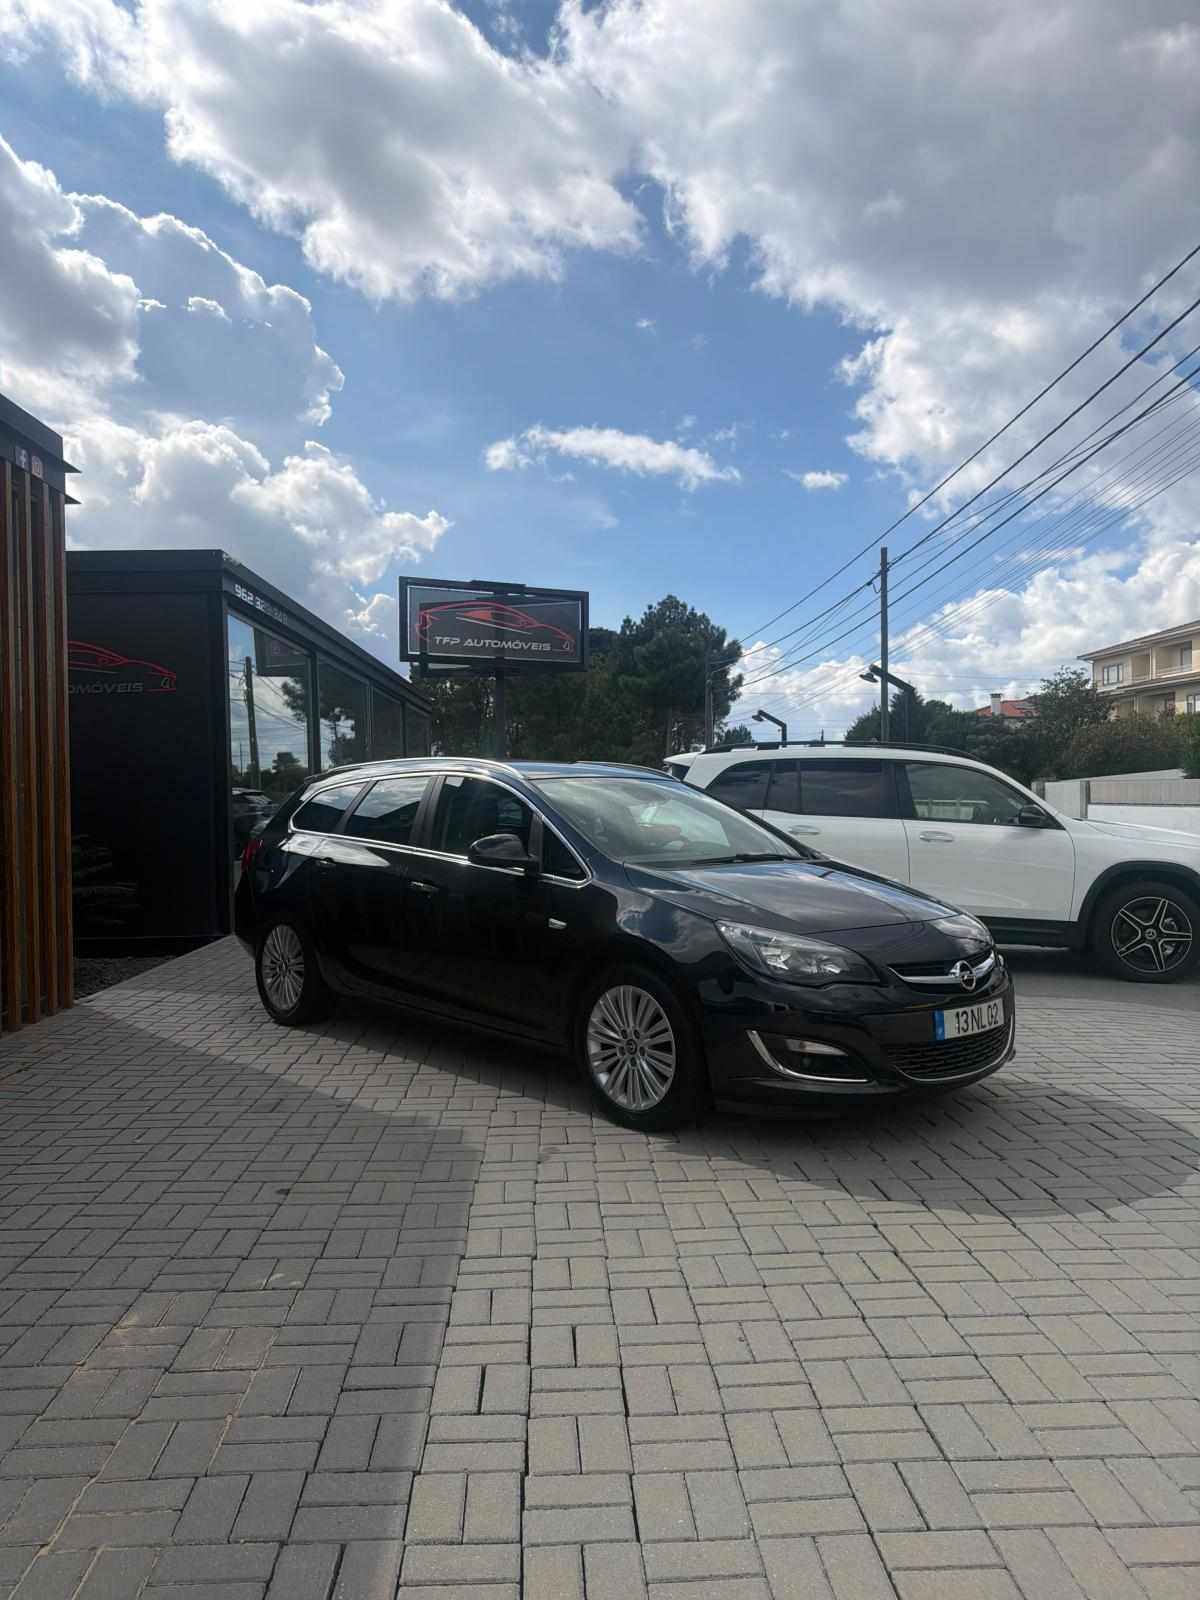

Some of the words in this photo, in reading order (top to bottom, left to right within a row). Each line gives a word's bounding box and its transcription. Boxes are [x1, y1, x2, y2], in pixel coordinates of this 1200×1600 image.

[234, 584, 254, 605] 962
[434, 636, 460, 646] TFP
[463, 638, 551, 651] AUTOMÓVEIS
